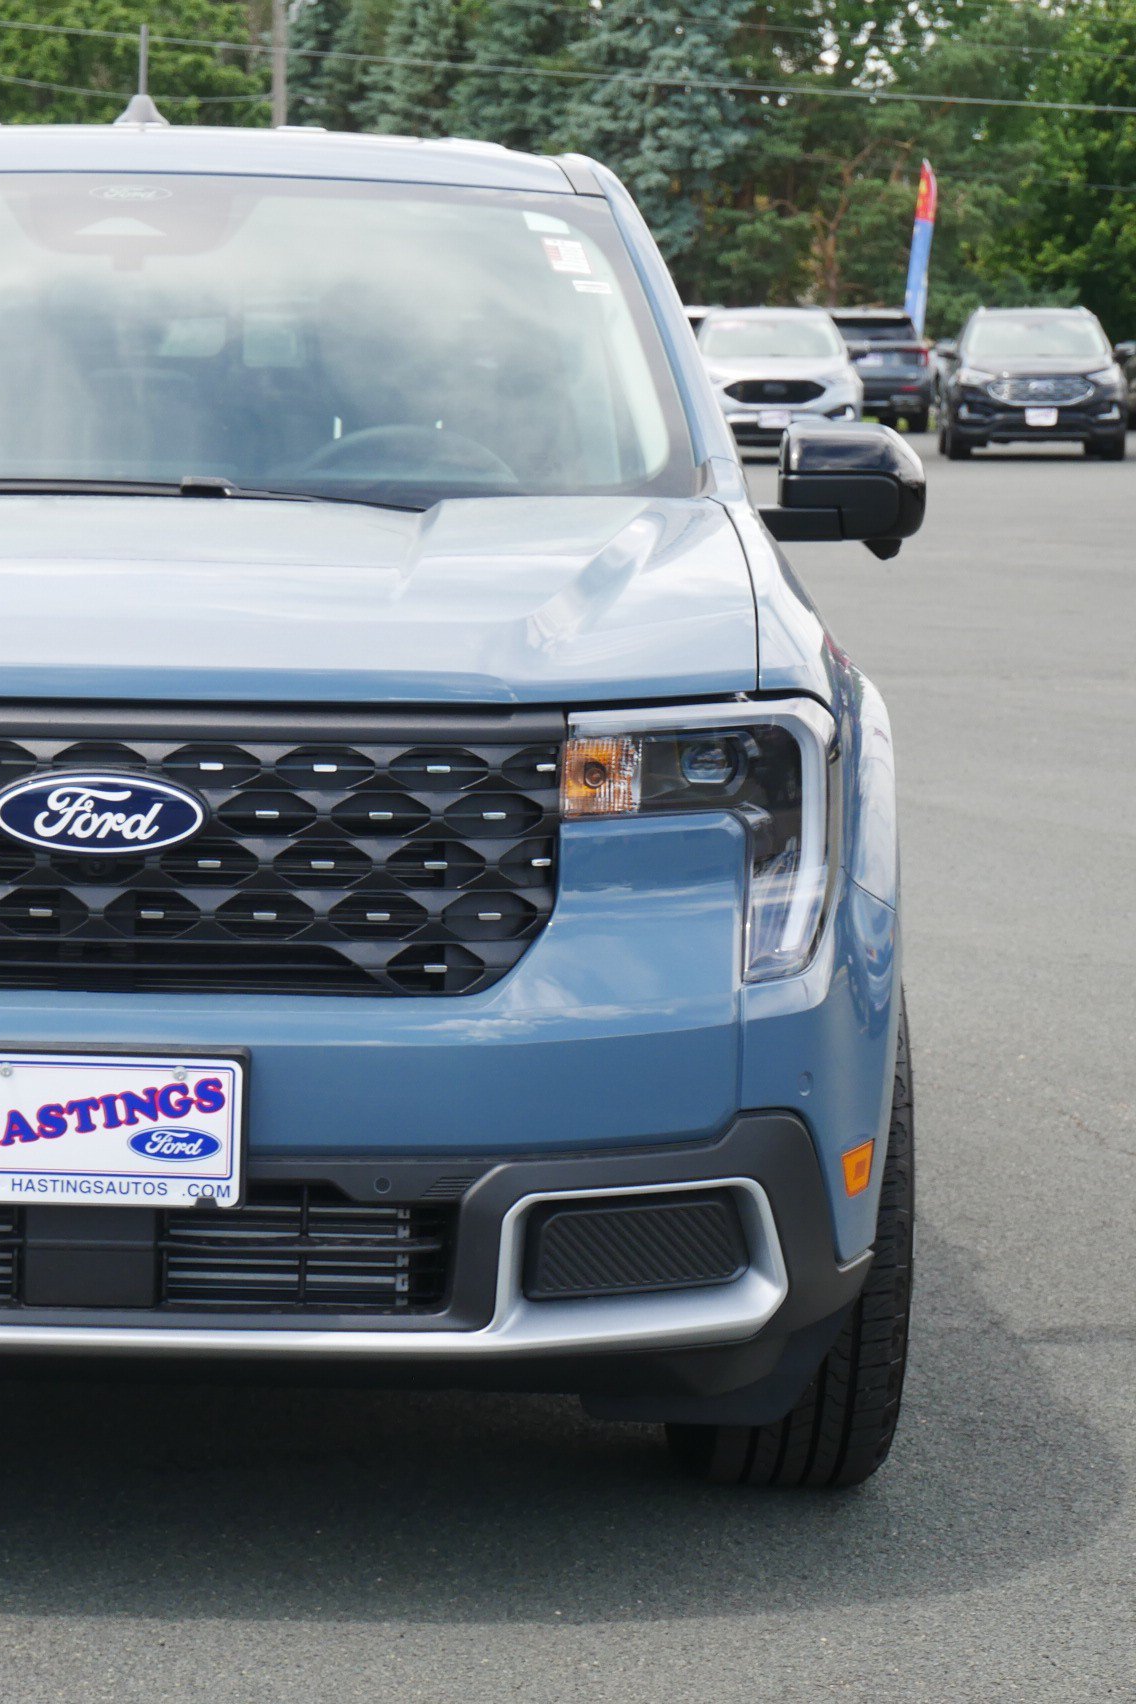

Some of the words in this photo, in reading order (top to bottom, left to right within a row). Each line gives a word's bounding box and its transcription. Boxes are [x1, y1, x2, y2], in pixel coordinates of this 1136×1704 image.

[103, 186, 158, 199] Ford
[33, 786, 164, 841] Ford
[145, 1130, 204, 1156] Ford
[11, 1178, 169, 1197] HASTINGSAUTOS
[181, 1183, 231, 1199] .COM
